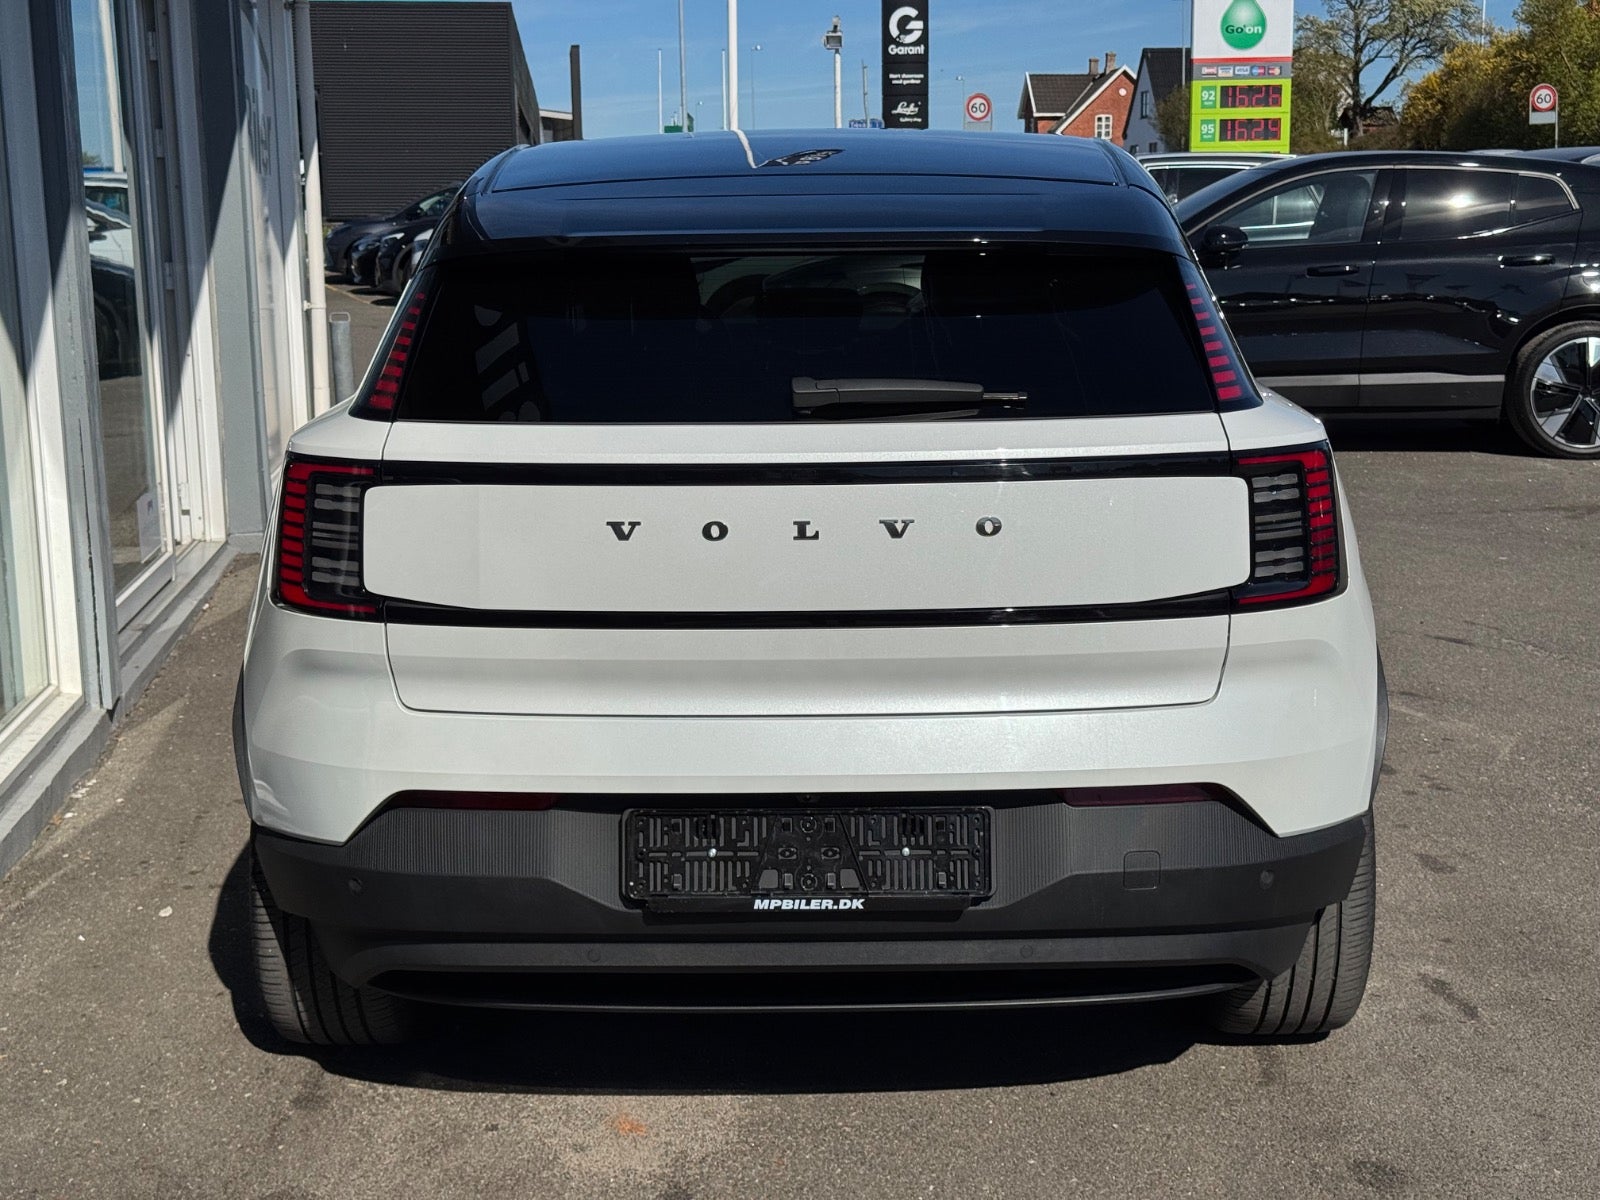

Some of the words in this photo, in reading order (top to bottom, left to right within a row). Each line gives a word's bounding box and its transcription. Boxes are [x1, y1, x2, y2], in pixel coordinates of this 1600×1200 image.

[887, 43, 925, 56] Garant
[1202, 90, 1215, 101] 92
[1536, 93, 1552, 104] 60
[971, 102, 987, 114] 60
[1201, 124, 1215, 135] 95
[606, 516, 1003, 541] VOLVO
[753, 899, 866, 910] MPBILER.DK
